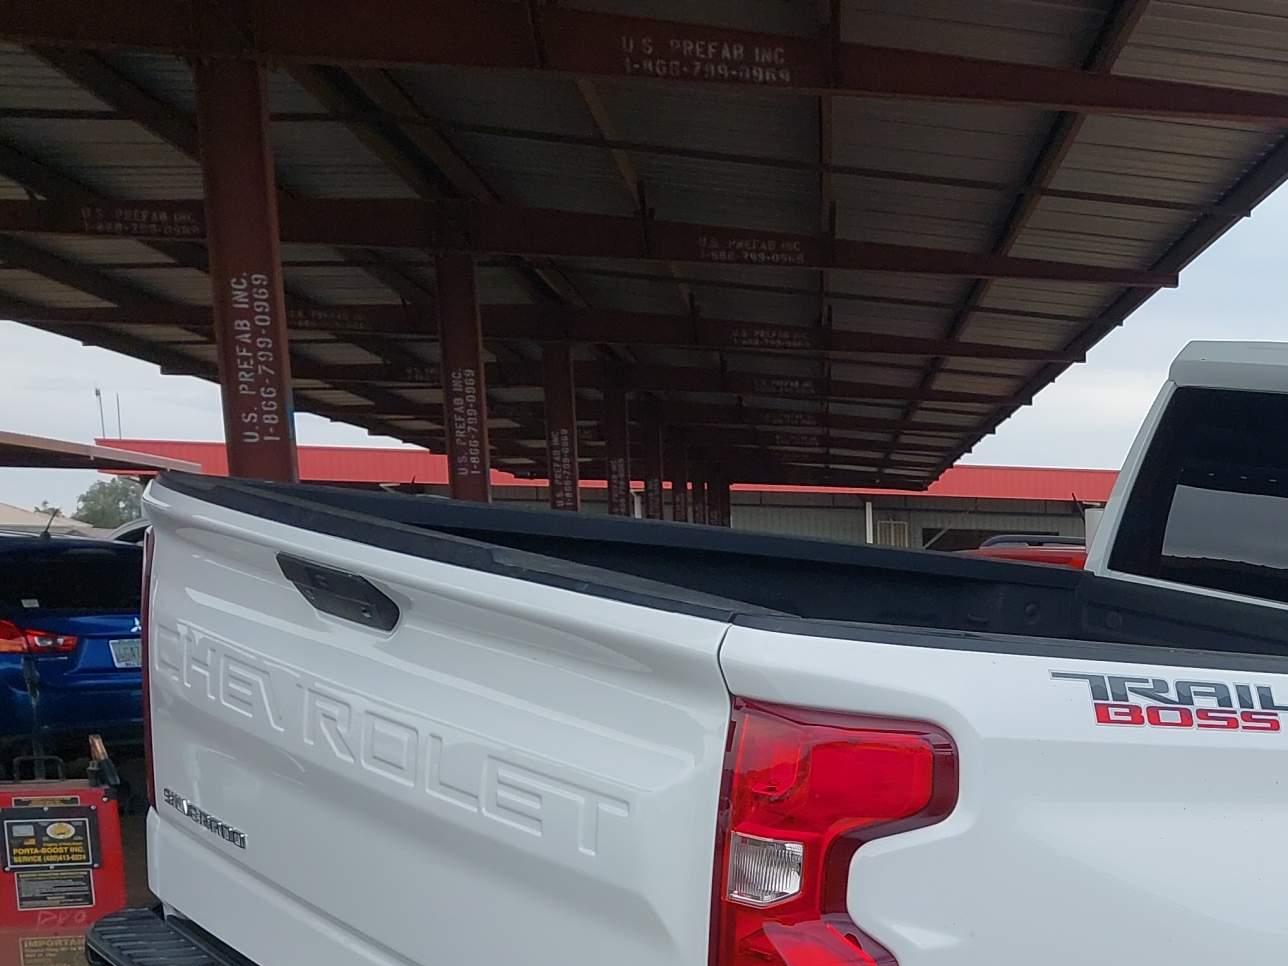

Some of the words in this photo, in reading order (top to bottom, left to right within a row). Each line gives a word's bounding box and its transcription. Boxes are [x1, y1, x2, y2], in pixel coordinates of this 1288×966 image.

[670, 39, 744, 60] PREFAB
[231, 272, 250, 309] INC.
[234, 318, 257, 394] PREFAB
[251, 273, 280, 441] 1-866-799-0969
[241, 406, 260, 443] U.S.
[453, 397, 467, 446] PREFAB
[155, 622, 631, 857] CHEVROLET
[1093, 702, 1281, 732] BOSS
[163, 787, 247, 850] SILVERADO
